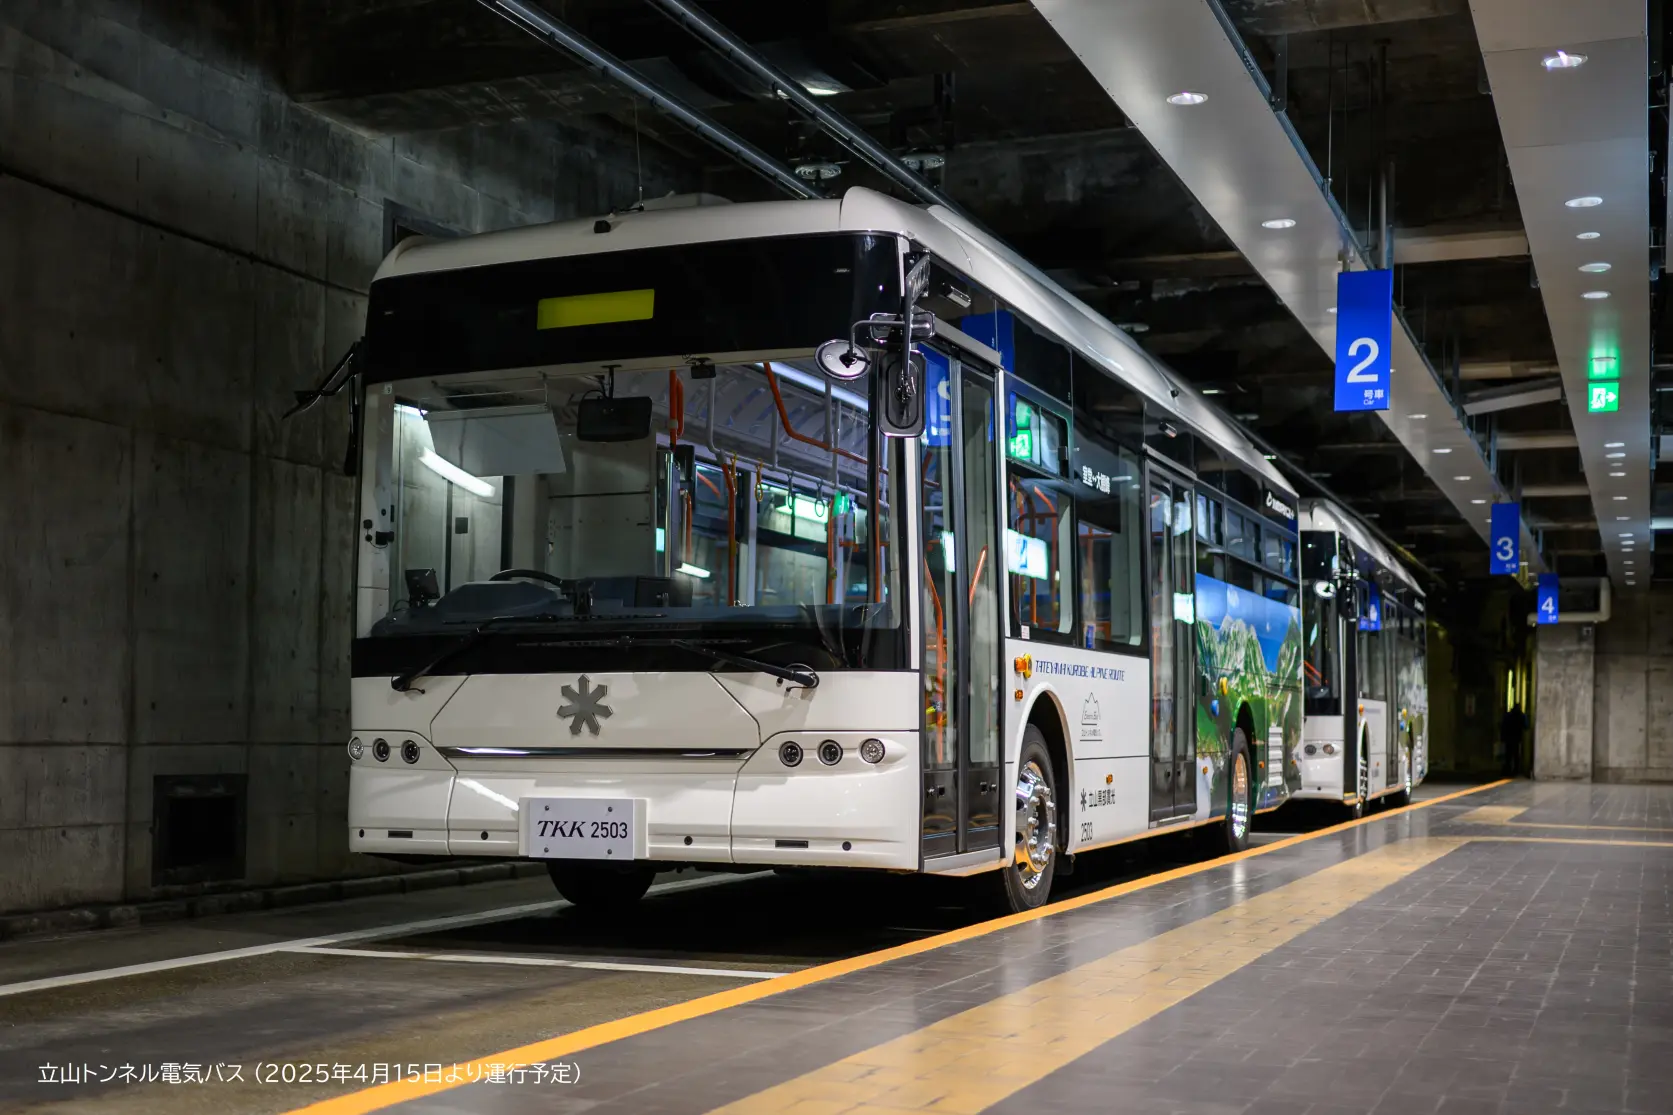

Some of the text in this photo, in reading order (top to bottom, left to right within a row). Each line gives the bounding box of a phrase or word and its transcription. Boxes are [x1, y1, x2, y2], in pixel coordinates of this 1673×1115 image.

[1346, 337, 1379, 383] 2
[1363, 389, 1385, 400] 号車
[1496, 536, 1514, 561] 3
[1541, 596, 1555, 614] 4
[1035, 659, 1126, 683] TATEYAMA KUROBE ALPINE ROUTE
[537, 820, 628, 839] TKK 2503
